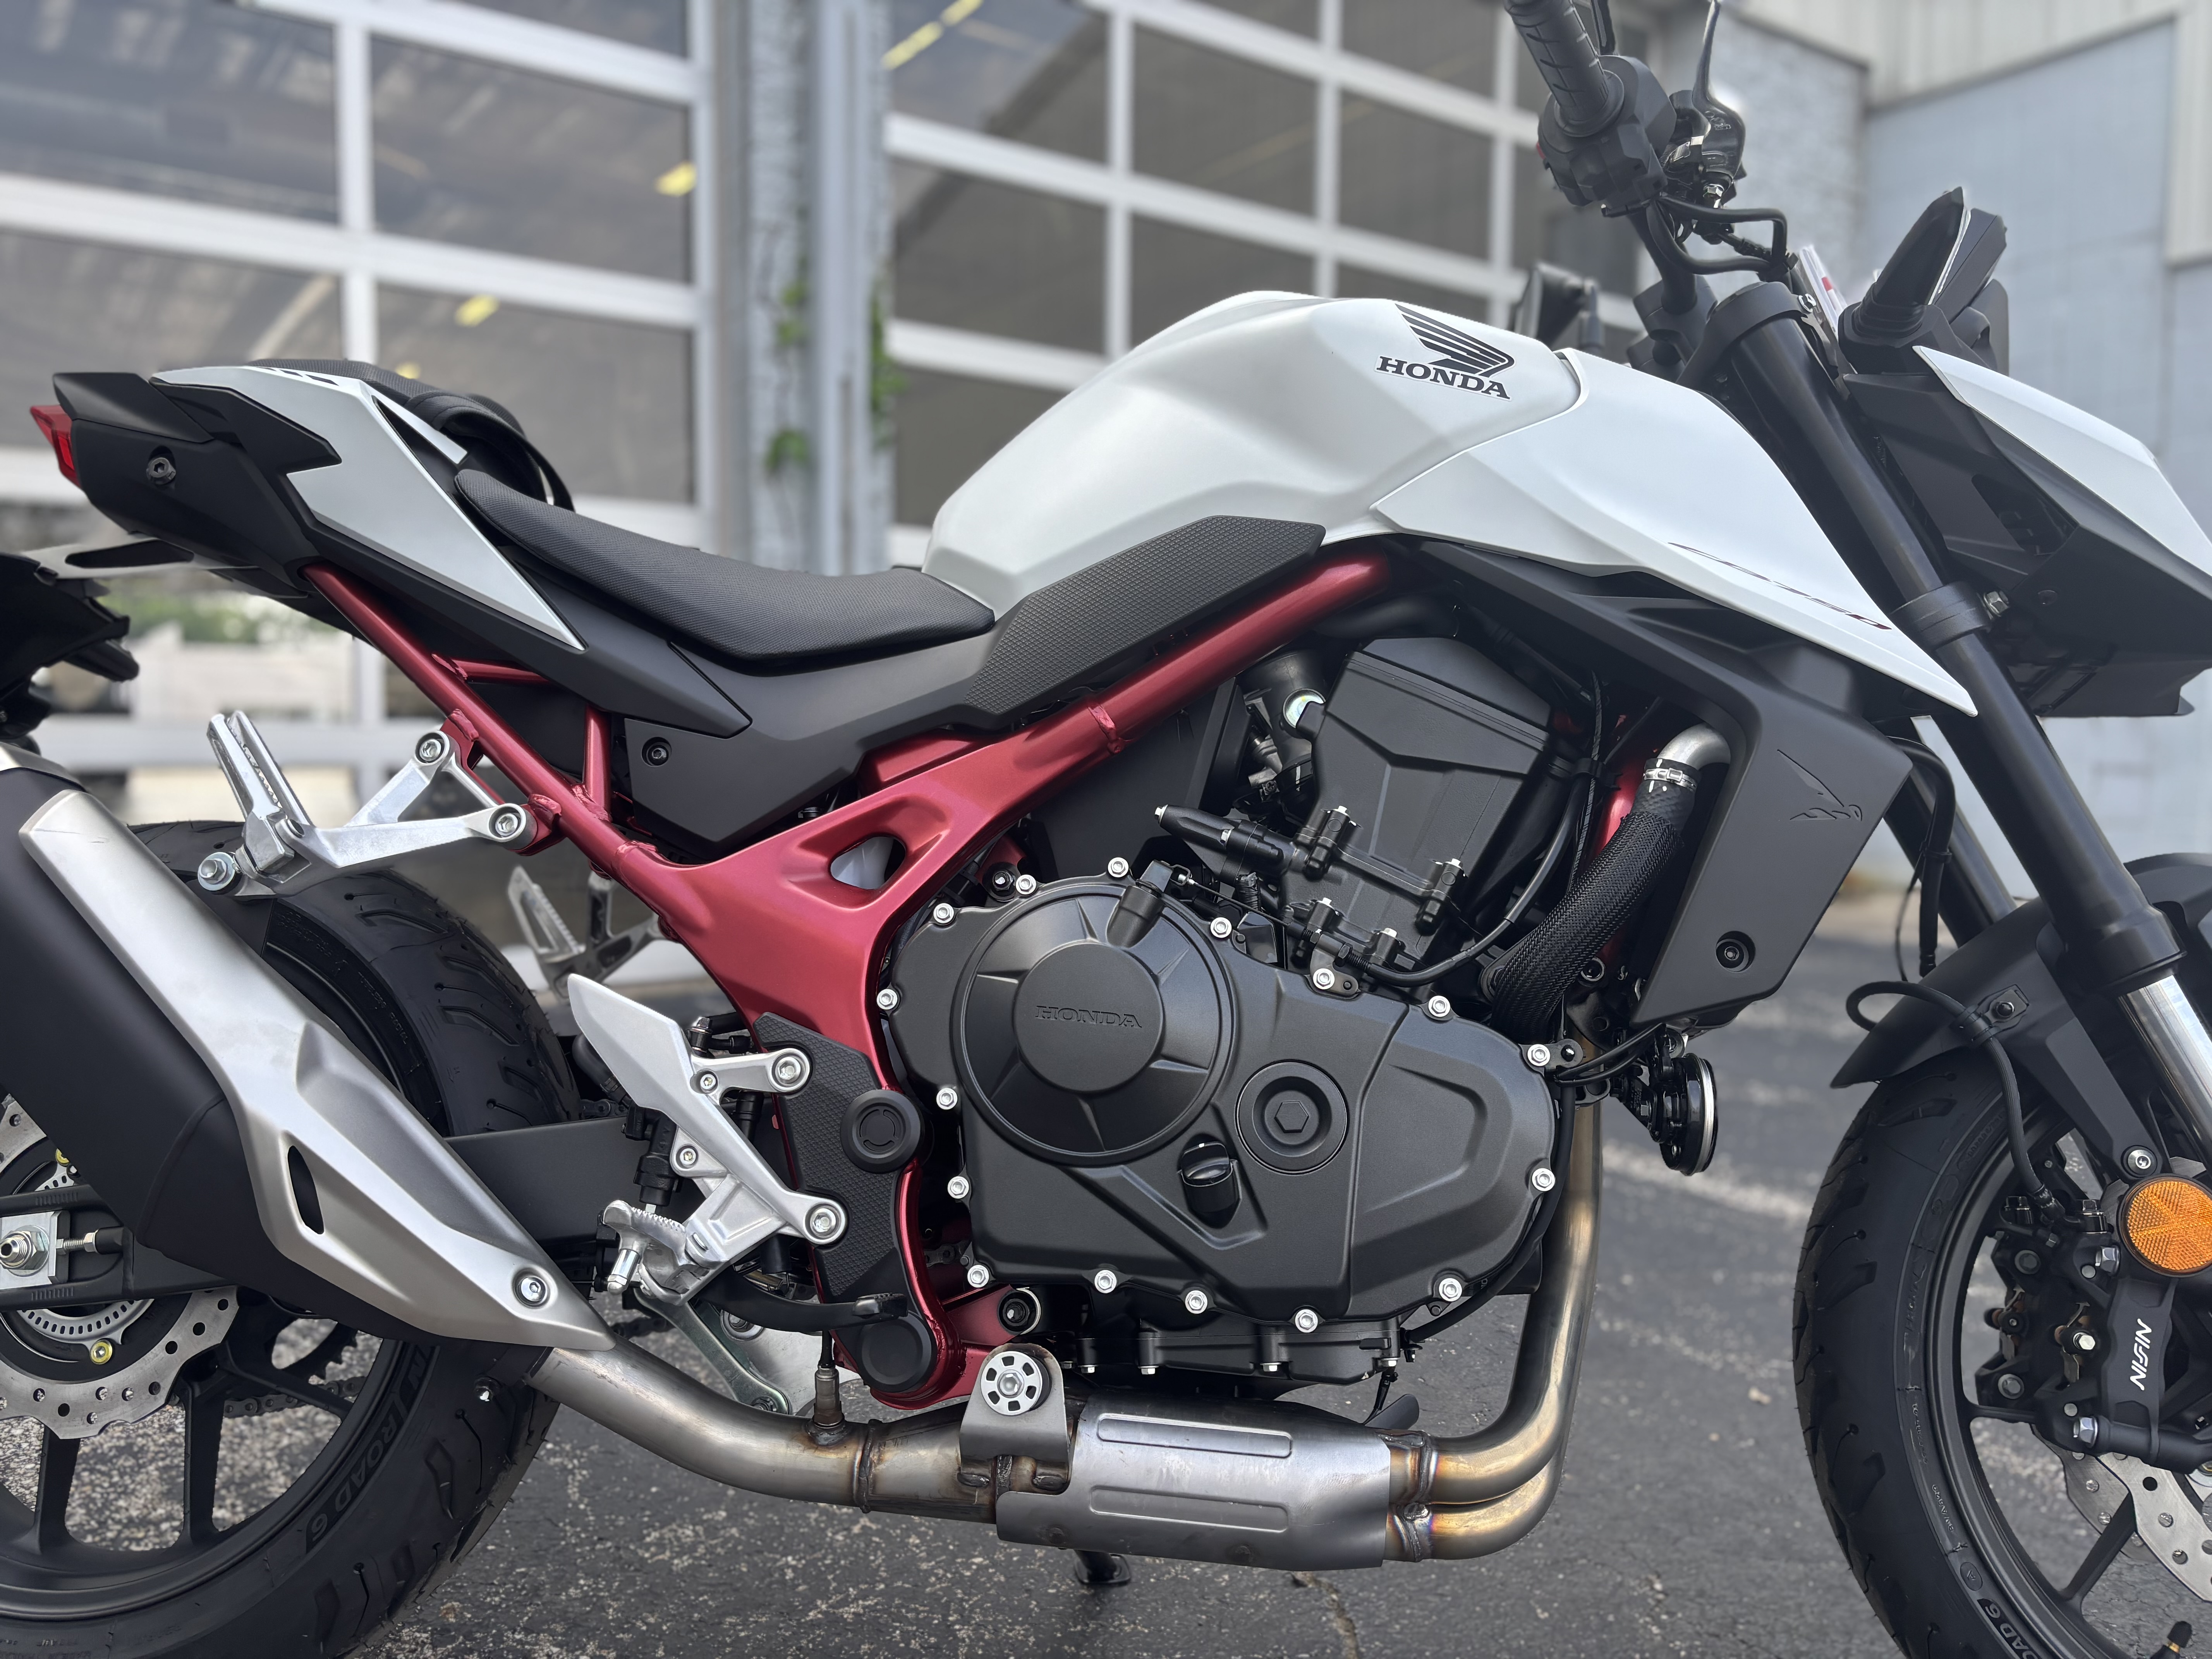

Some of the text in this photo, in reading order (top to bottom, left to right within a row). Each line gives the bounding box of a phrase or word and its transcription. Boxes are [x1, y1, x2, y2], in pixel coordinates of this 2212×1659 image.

[1377, 356, 1510, 400] HONDA
[1035, 1005, 1142, 1029] HONDA
[311, 1414, 397, 1541] ROAD 6
[1985, 1603, 2001, 1618] 6
